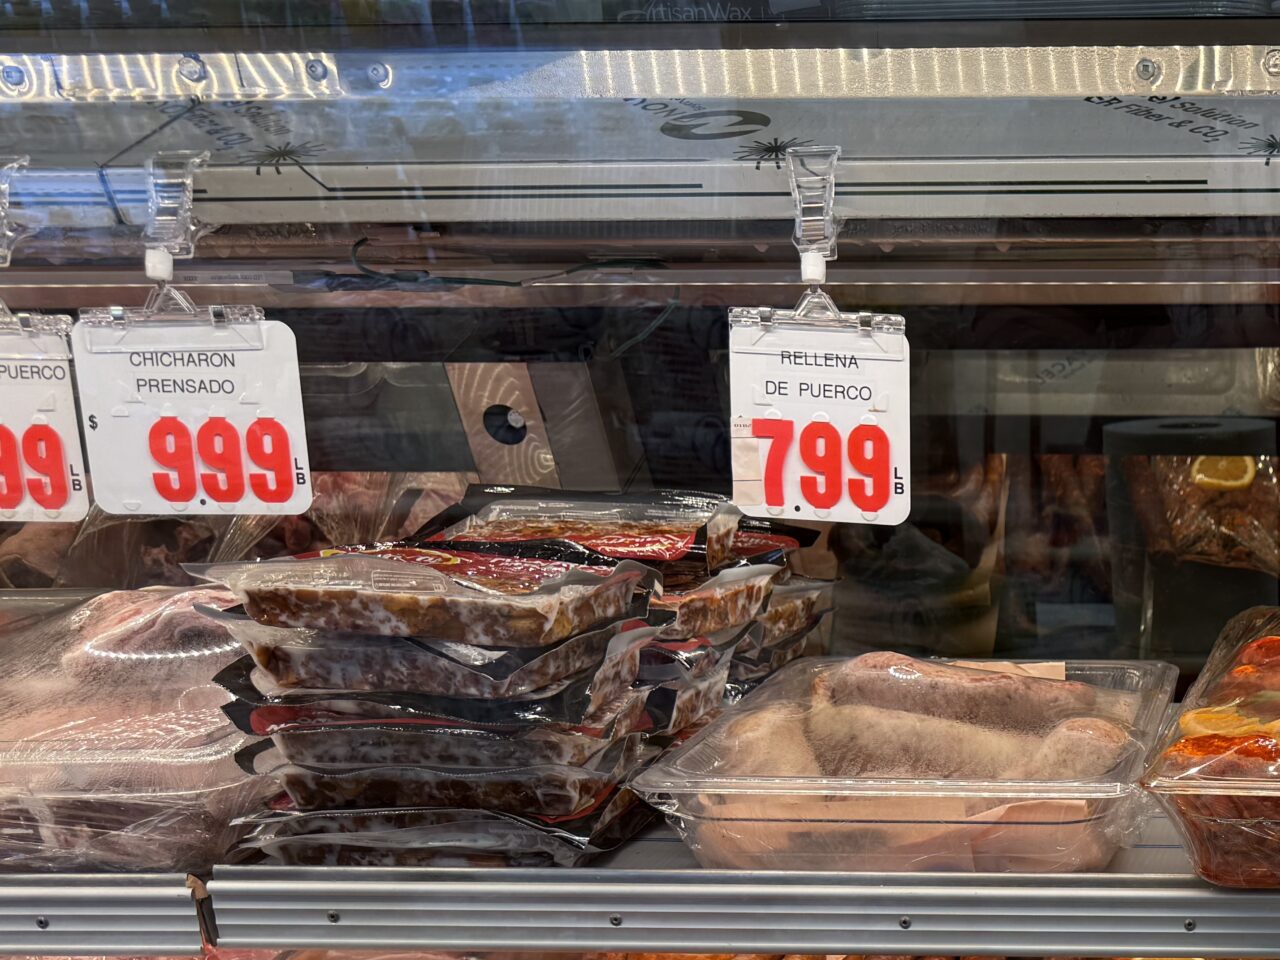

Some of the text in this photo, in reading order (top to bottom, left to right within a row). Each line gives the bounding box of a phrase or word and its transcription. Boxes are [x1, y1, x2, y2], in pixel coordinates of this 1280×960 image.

[129, 351, 236, 367] CHICHARON
[780, 350, 859, 369] RELLENA
[0, 365, 66, 380] PUERCO
[136, 378, 235, 394] PRENSADO
[765, 380, 872, 400] DE PUERCO
